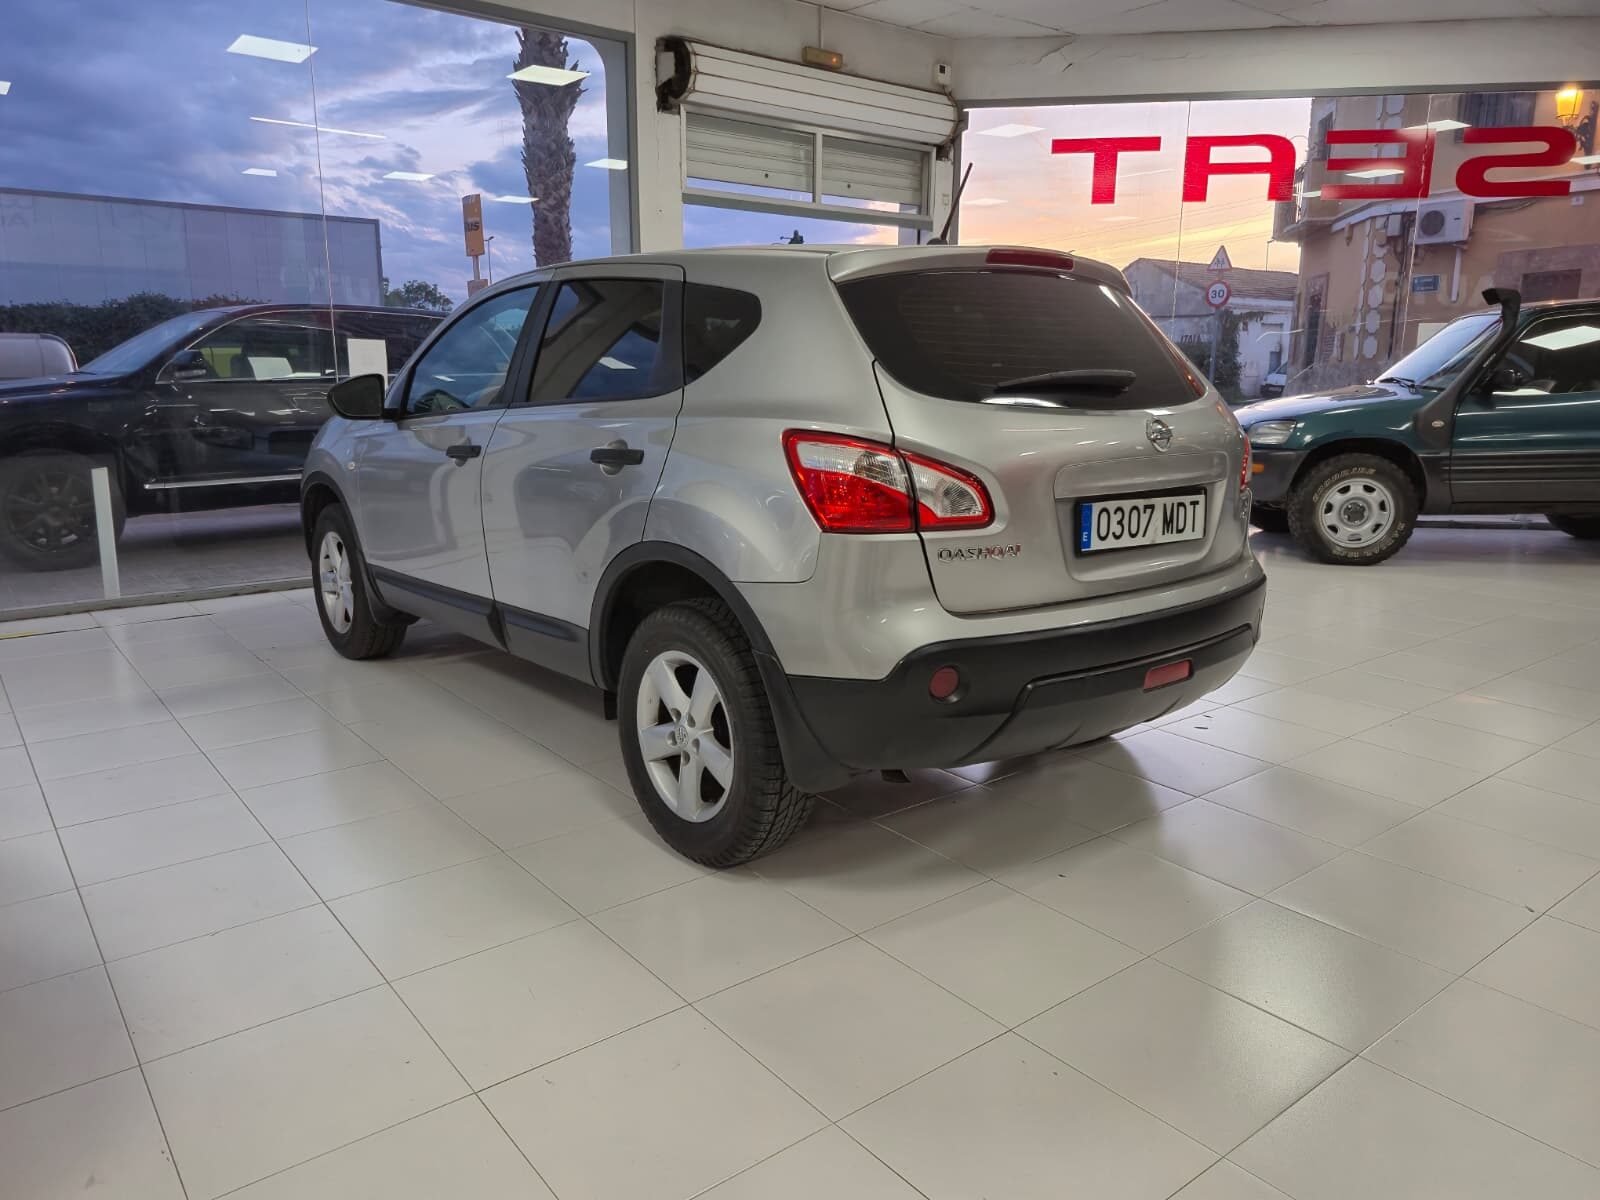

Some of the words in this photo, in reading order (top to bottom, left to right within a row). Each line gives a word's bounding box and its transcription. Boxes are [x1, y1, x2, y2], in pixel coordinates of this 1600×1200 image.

[1211, 289, 1225, 299] 30
[1096, 504, 1156, 542] 0307
[1161, 500, 1200, 536] MDT
[1082, 531, 1089, 542] E
[937, 543, 1022, 564] QASHQAI
